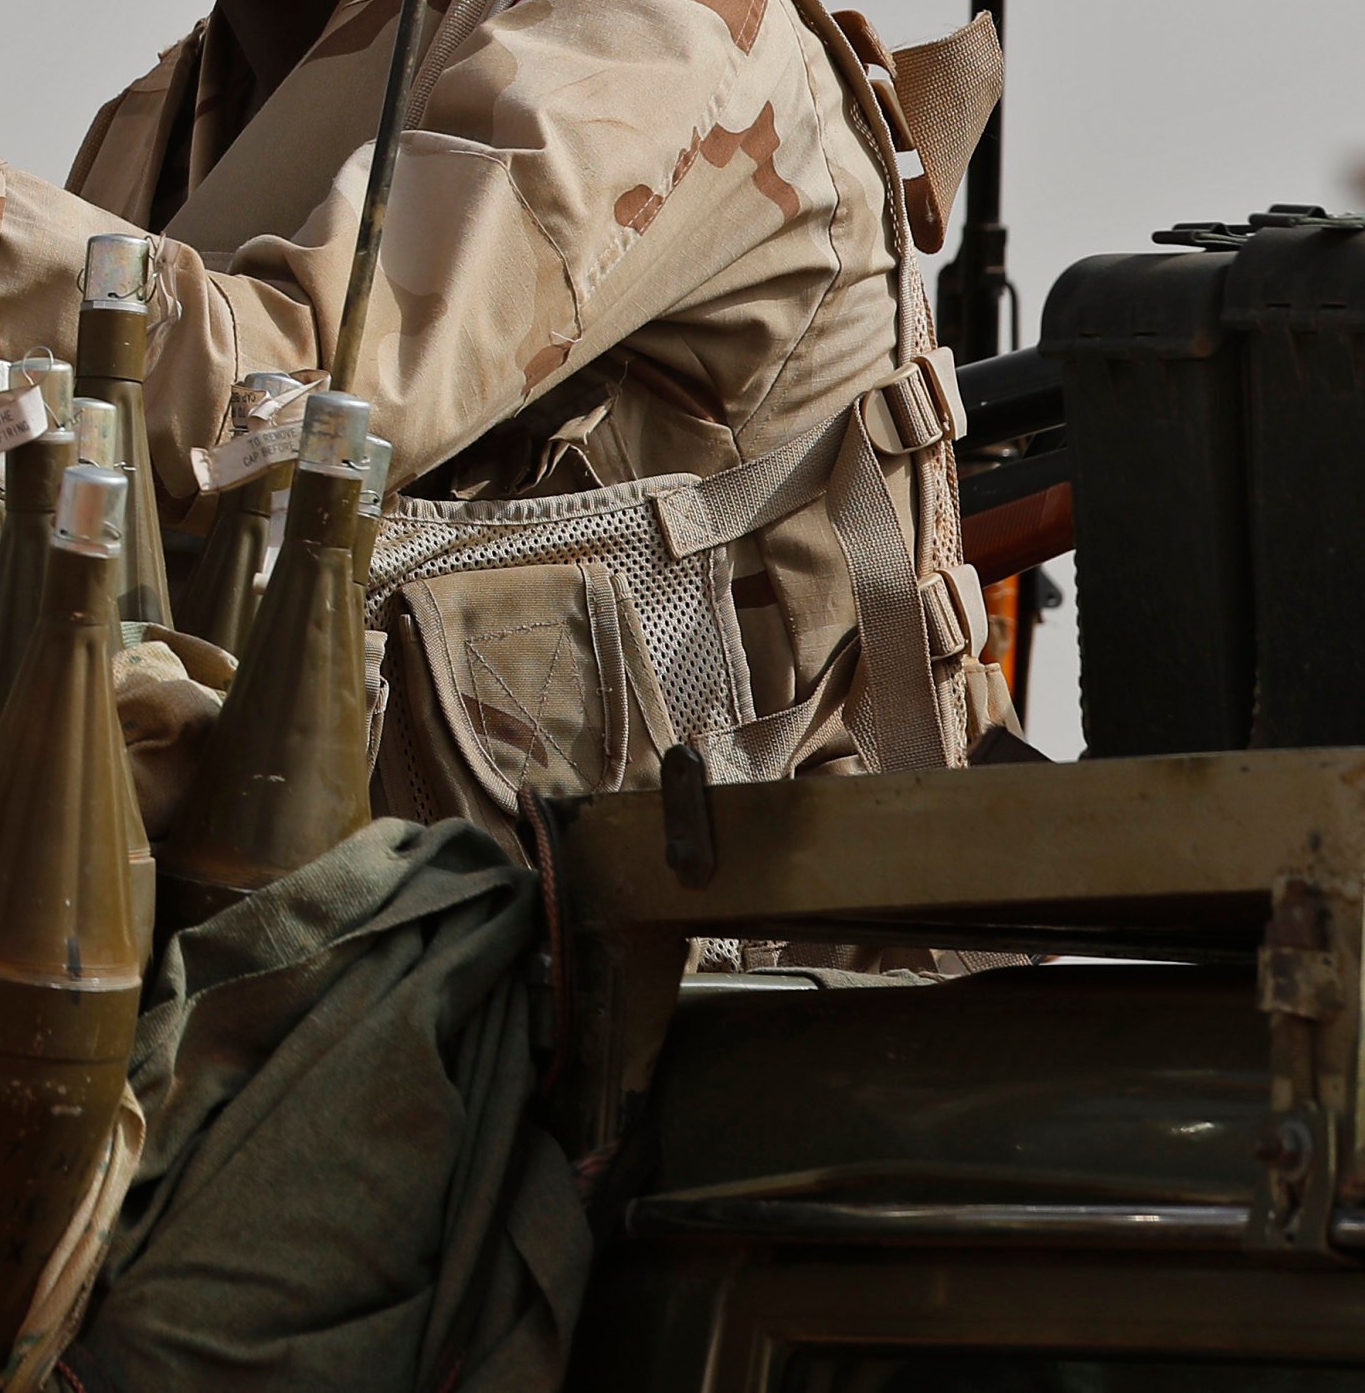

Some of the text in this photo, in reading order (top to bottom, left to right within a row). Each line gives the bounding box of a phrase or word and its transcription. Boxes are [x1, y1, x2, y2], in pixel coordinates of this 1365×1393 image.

[247, 428, 298, 450] TO REMOVE
[243, 452, 259, 467] CAP
